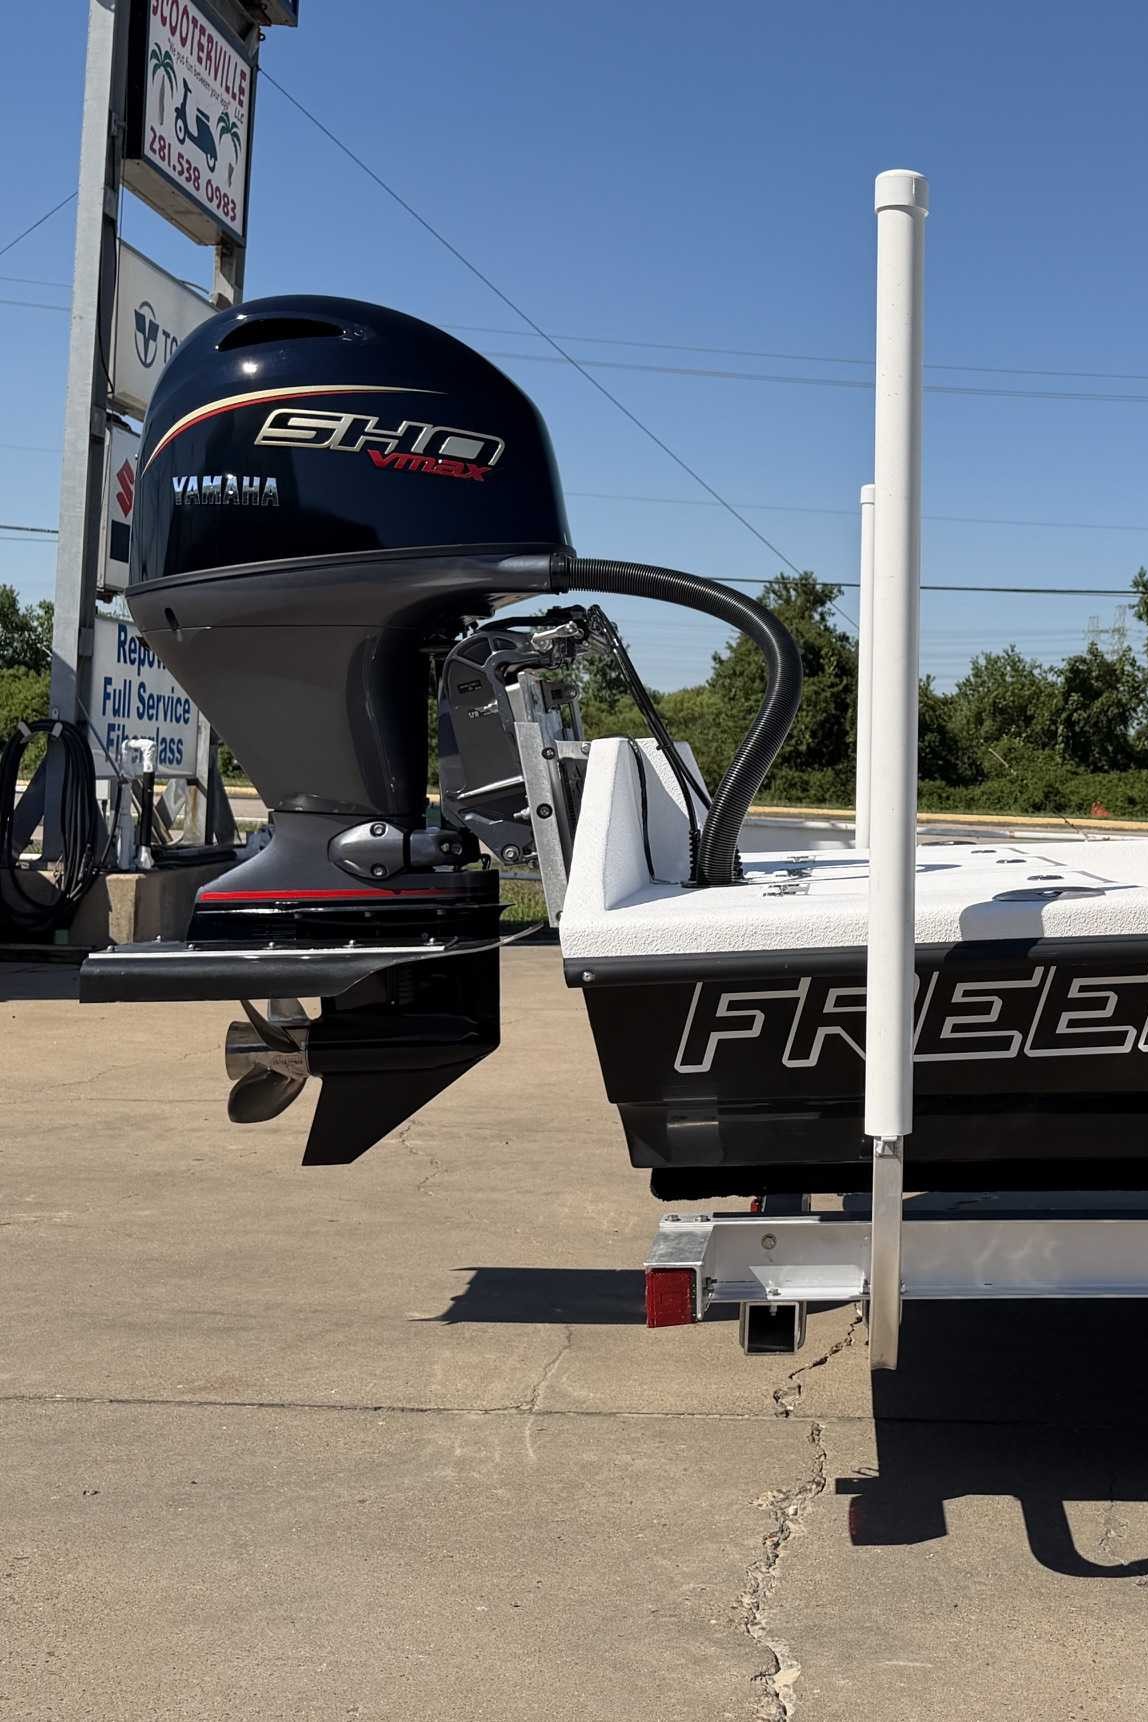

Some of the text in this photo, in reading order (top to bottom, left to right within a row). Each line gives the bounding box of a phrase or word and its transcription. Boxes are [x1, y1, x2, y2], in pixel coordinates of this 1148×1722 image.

[234, 108, 245, 125] LLC
[150, 126, 237, 222] 281.538 0983
[254, 408, 505, 466] SHO
[172, 475, 280, 507] YAMAHA
[102, 677, 191, 725] Full Service
